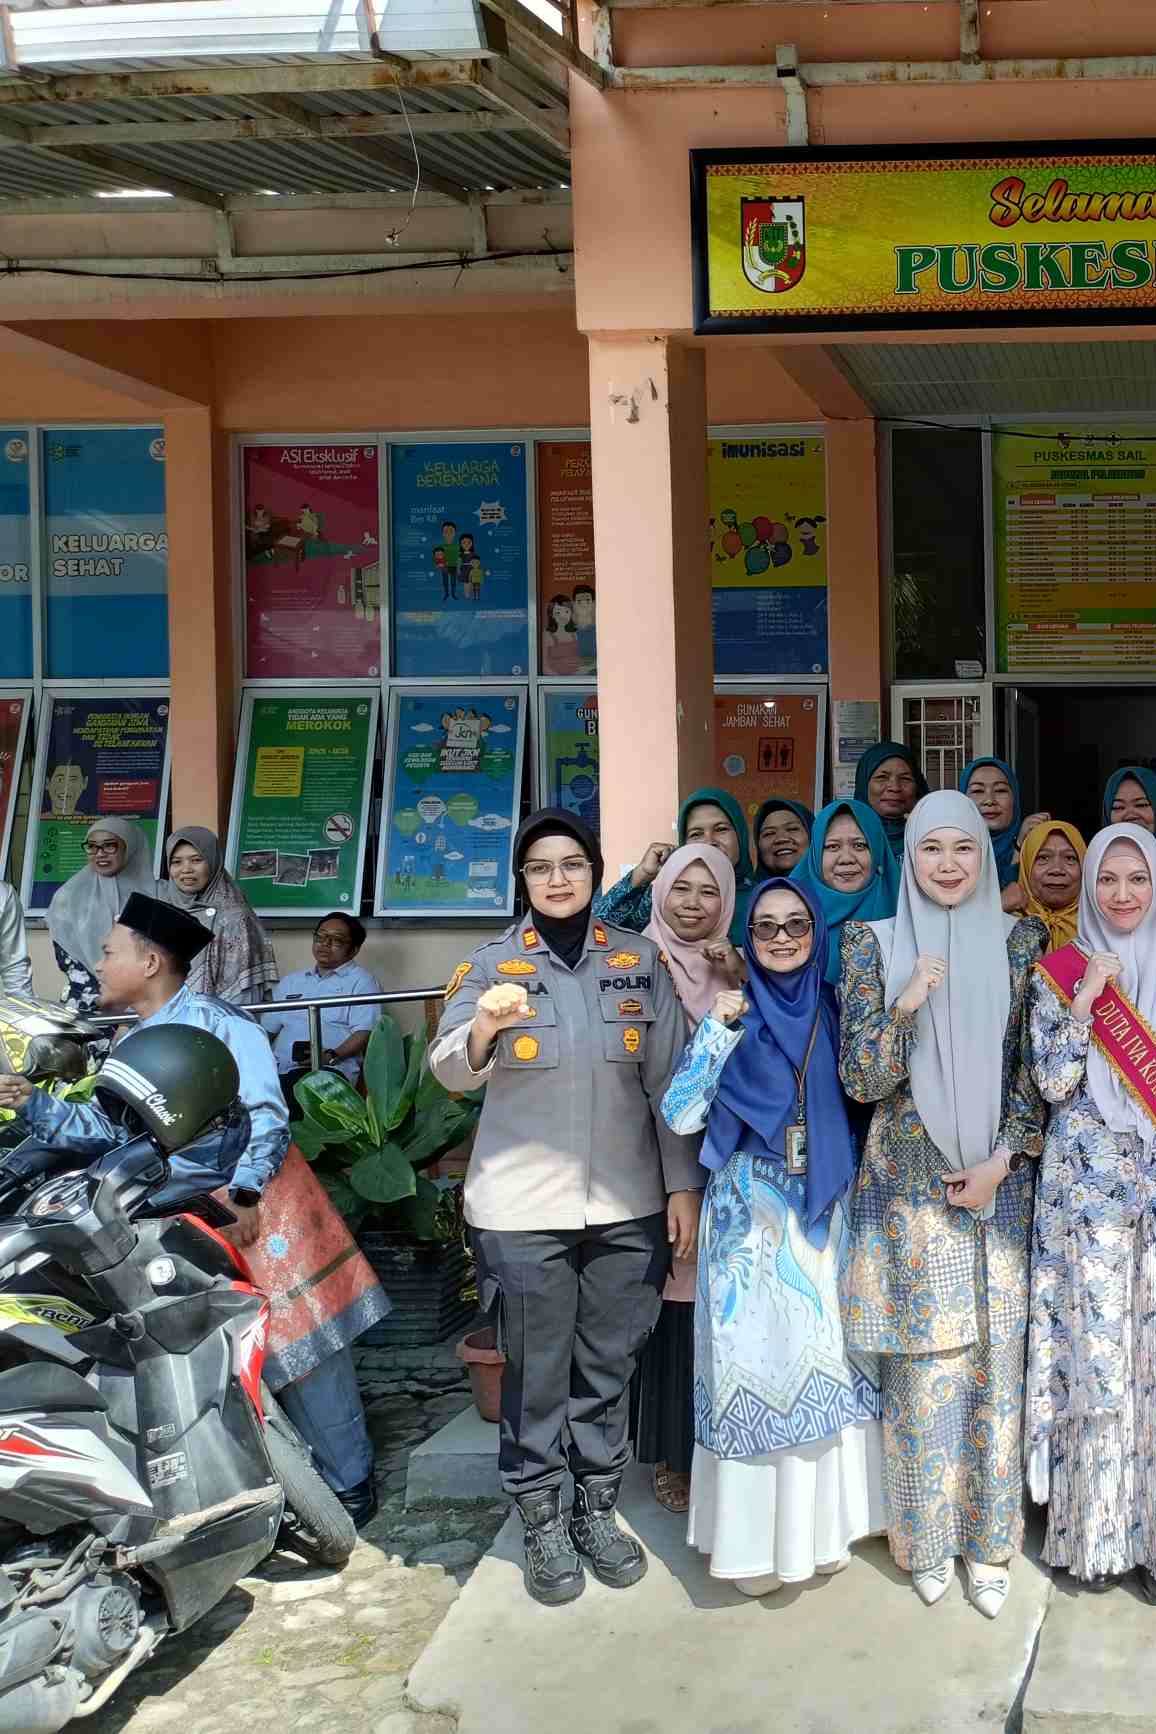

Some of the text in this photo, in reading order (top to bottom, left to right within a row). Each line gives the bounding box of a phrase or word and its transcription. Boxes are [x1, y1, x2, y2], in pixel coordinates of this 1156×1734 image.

[281, 448, 360, 464] ASI Eksklusif
[721, 441, 805, 459] imunisasi
[1034, 449, 1147, 463] PUSKESMAS SAIL
[52, 533, 168, 554] KELUARGA
[52, 558, 124, 578] SEHAT
[286, 720, 352, 731] MEROKOK
[722, 715, 792, 729] JAMBAN SEHAT
[600, 976, 652, 992] POLRI
[1096, 1000, 1131, 1043] DUTA
[1121, 1035, 1149, 1068] IVA
[146, 1093, 184, 1127] Classic
